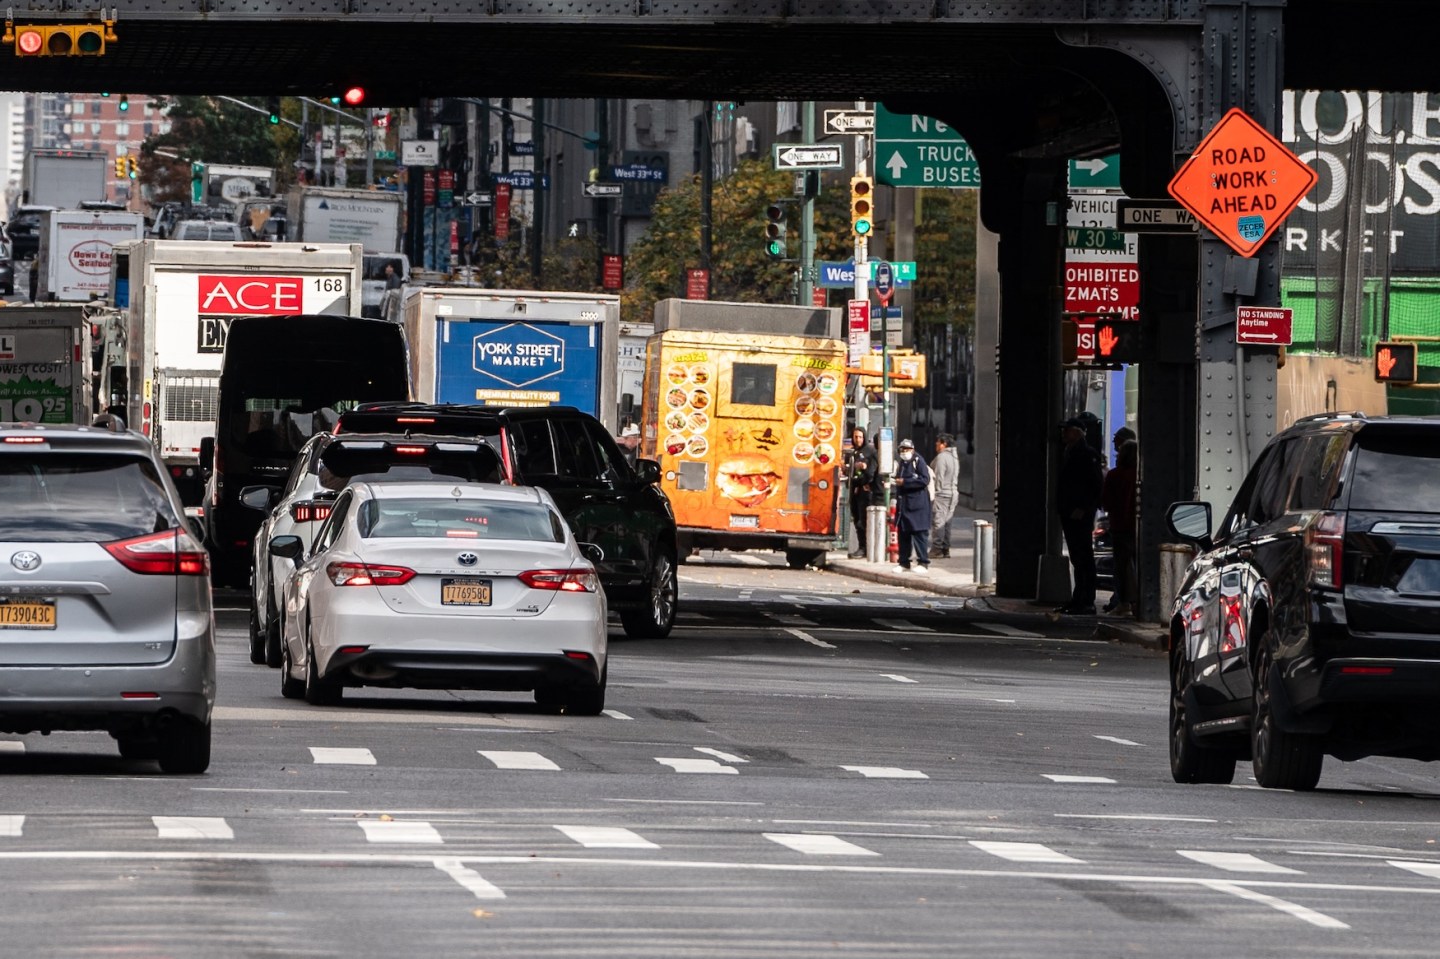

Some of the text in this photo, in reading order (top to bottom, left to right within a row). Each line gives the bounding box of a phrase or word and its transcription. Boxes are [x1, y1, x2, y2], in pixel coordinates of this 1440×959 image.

[835, 118, 874, 127] ONE W
[787, 152, 832, 161] ONE WAY
[1212, 146, 1266, 166] ROAD
[614, 168, 636, 178] West
[653, 171, 662, 180] St
[923, 166, 981, 183] BUSES
[1213, 171, 1268, 190] WORK
[1210, 194, 1277, 214] AHEAD
[1132, 210, 1162, 223] ONE
[1066, 230, 1122, 248] W 30 ST
[1066, 268, 1139, 282] OHIBITED
[314, 279, 343, 292] 168
[202, 281, 300, 311] ACE
[1067, 287, 1119, 301] ZMATS
[1241, 310, 1285, 319] NO STANDING
[1240, 318, 1269, 328] Anytime
[477, 342, 513, 361] YORK
[492, 356, 545, 367] MARKET
[32, 363, 62, 374] COST!
[511, 390, 538, 400] QUALITY
[540, 392, 557, 401] FOOD
[446, 587, 488, 600] T776958C
[0, 606, 51, 623] T739043C
